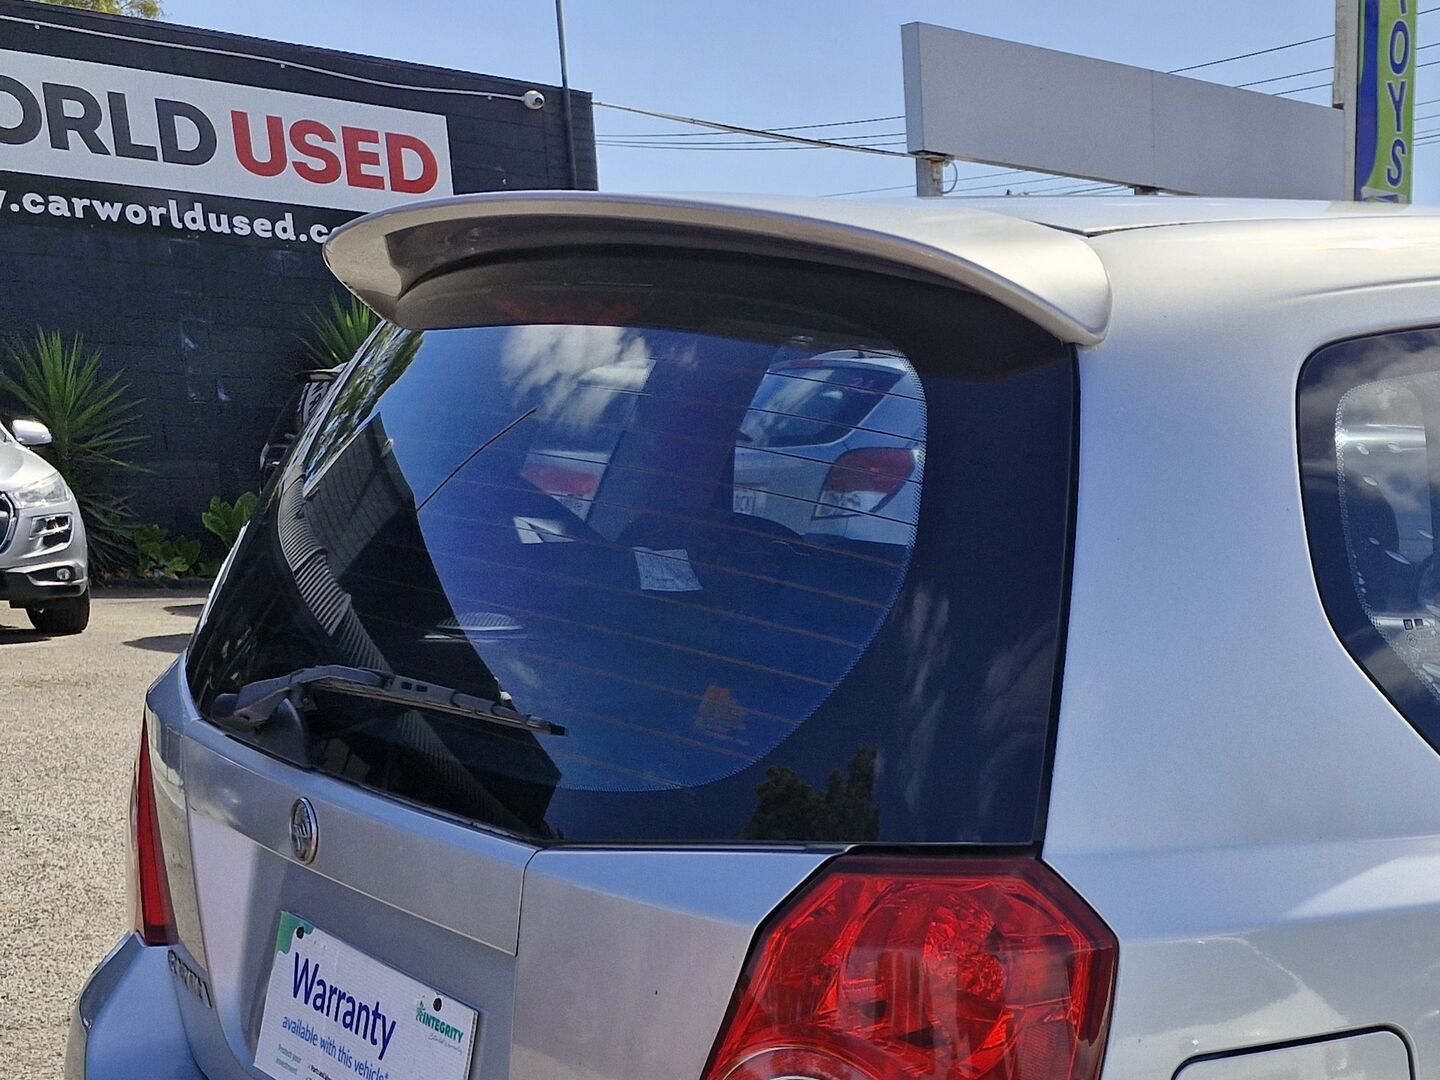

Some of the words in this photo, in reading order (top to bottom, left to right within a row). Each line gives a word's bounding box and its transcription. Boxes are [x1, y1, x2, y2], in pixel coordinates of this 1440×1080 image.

[1386, 0, 1409, 187] OYS
[230, 110, 439, 194] USED
[0, 190, 341, 244] .carworldused.c
[293, 951, 397, 1060] Warranty
[422, 1011, 464, 1044] INTEGRITY
[282, 1016, 319, 1046] available
[320, 1036, 337, 1059] with
[338, 1046, 352, 1069] this
